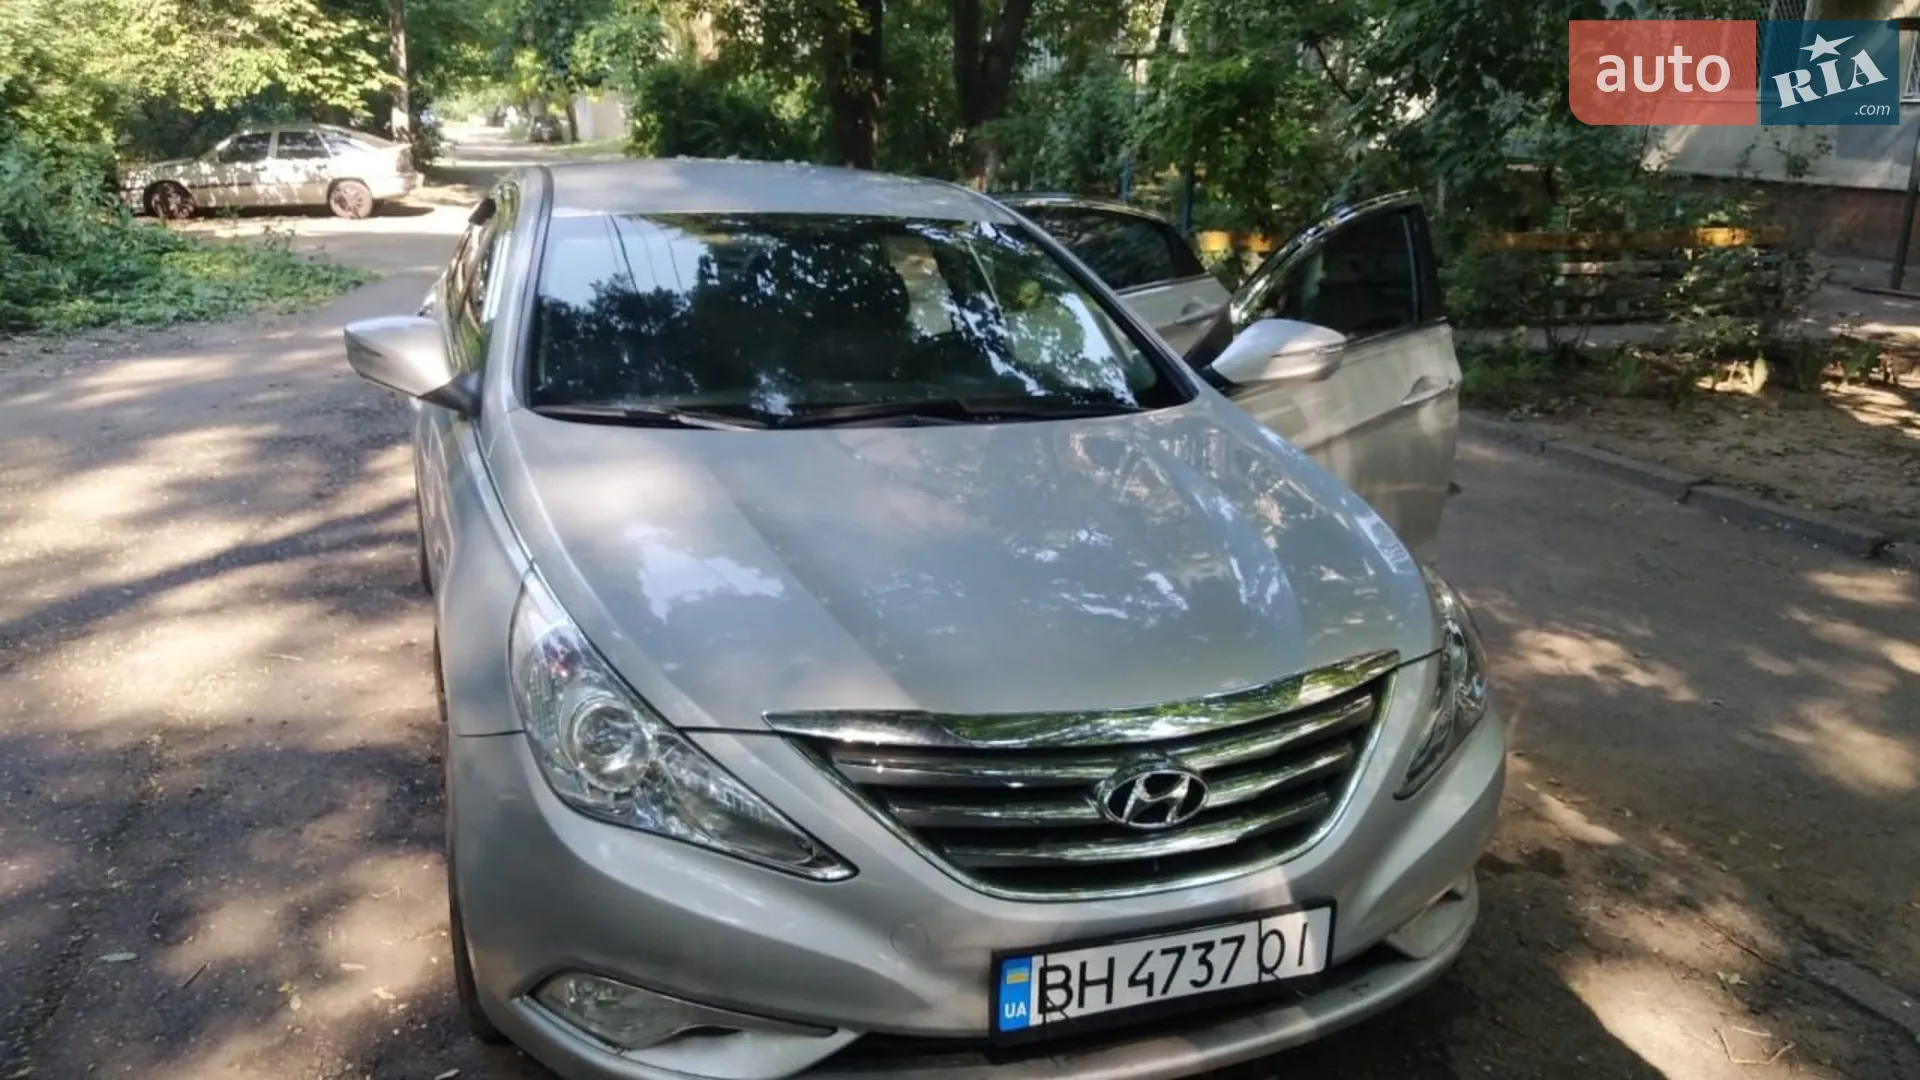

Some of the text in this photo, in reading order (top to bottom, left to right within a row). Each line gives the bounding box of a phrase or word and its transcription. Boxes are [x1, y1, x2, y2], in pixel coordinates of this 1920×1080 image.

[1037, 956, 1115, 1015] BH
[1127, 934, 1246, 998] 4737
[1004, 1002, 1028, 1019] UA
